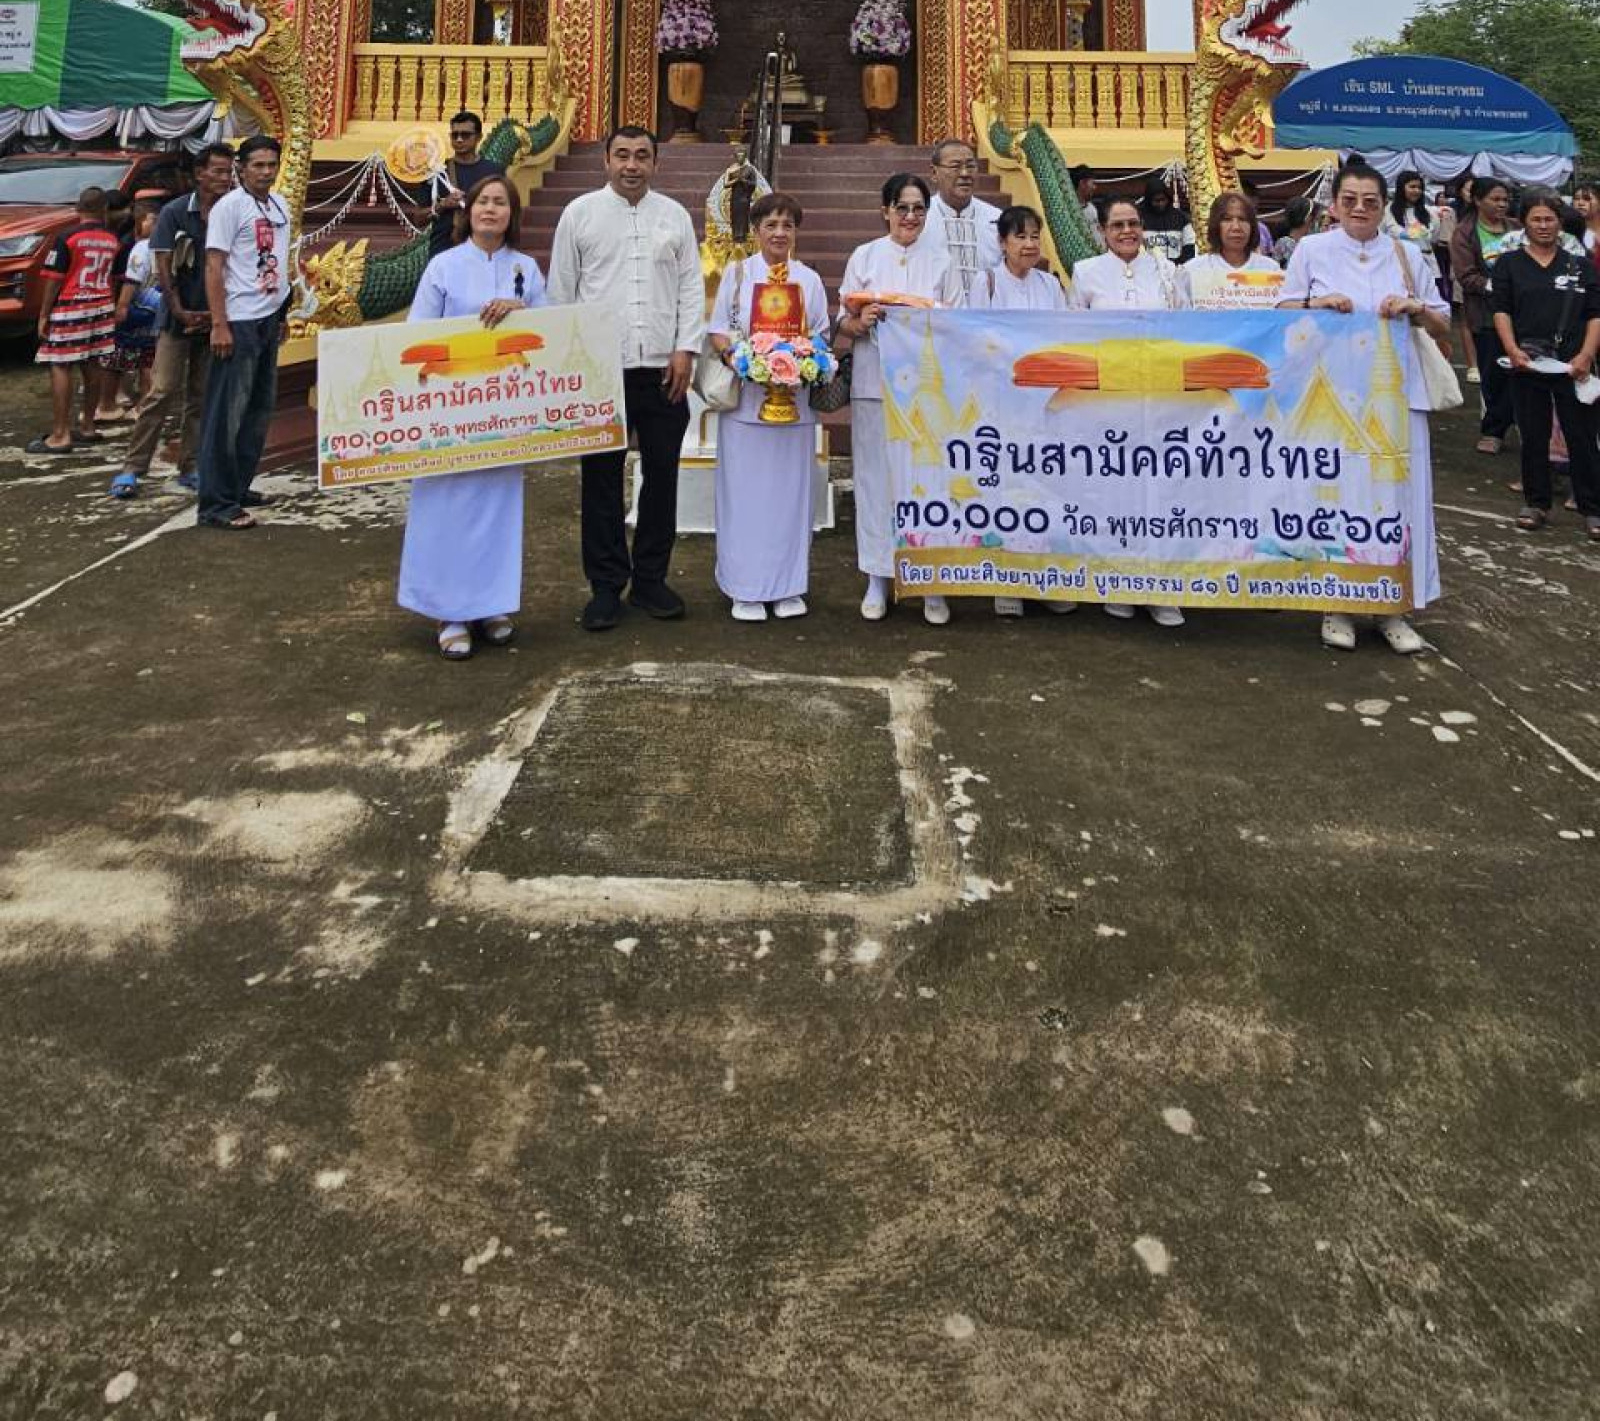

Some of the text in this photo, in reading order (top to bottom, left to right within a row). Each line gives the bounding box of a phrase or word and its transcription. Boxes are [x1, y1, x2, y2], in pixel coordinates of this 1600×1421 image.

[1370, 81, 1395, 93] SML
[361, 366, 583, 423] กฐินสามัคคีทั่วไทย
[330, 400, 615, 452] ๓๐,๐๐๐ วัด พุทธศักราช ๒๕๖๘
[946, 414, 1341, 487] กฐินสามัคคีทั่วไทย
[896, 500, 1403, 548] ๓๐,๐๐๐ วัด พุทธศักราช ๒๕๖๘
[901, 561, 1402, 601] โดย คณะศิษยานุศิษย์ บูชาธรรม ๘๑ ปี หลวงพ่อธัมมชโย
